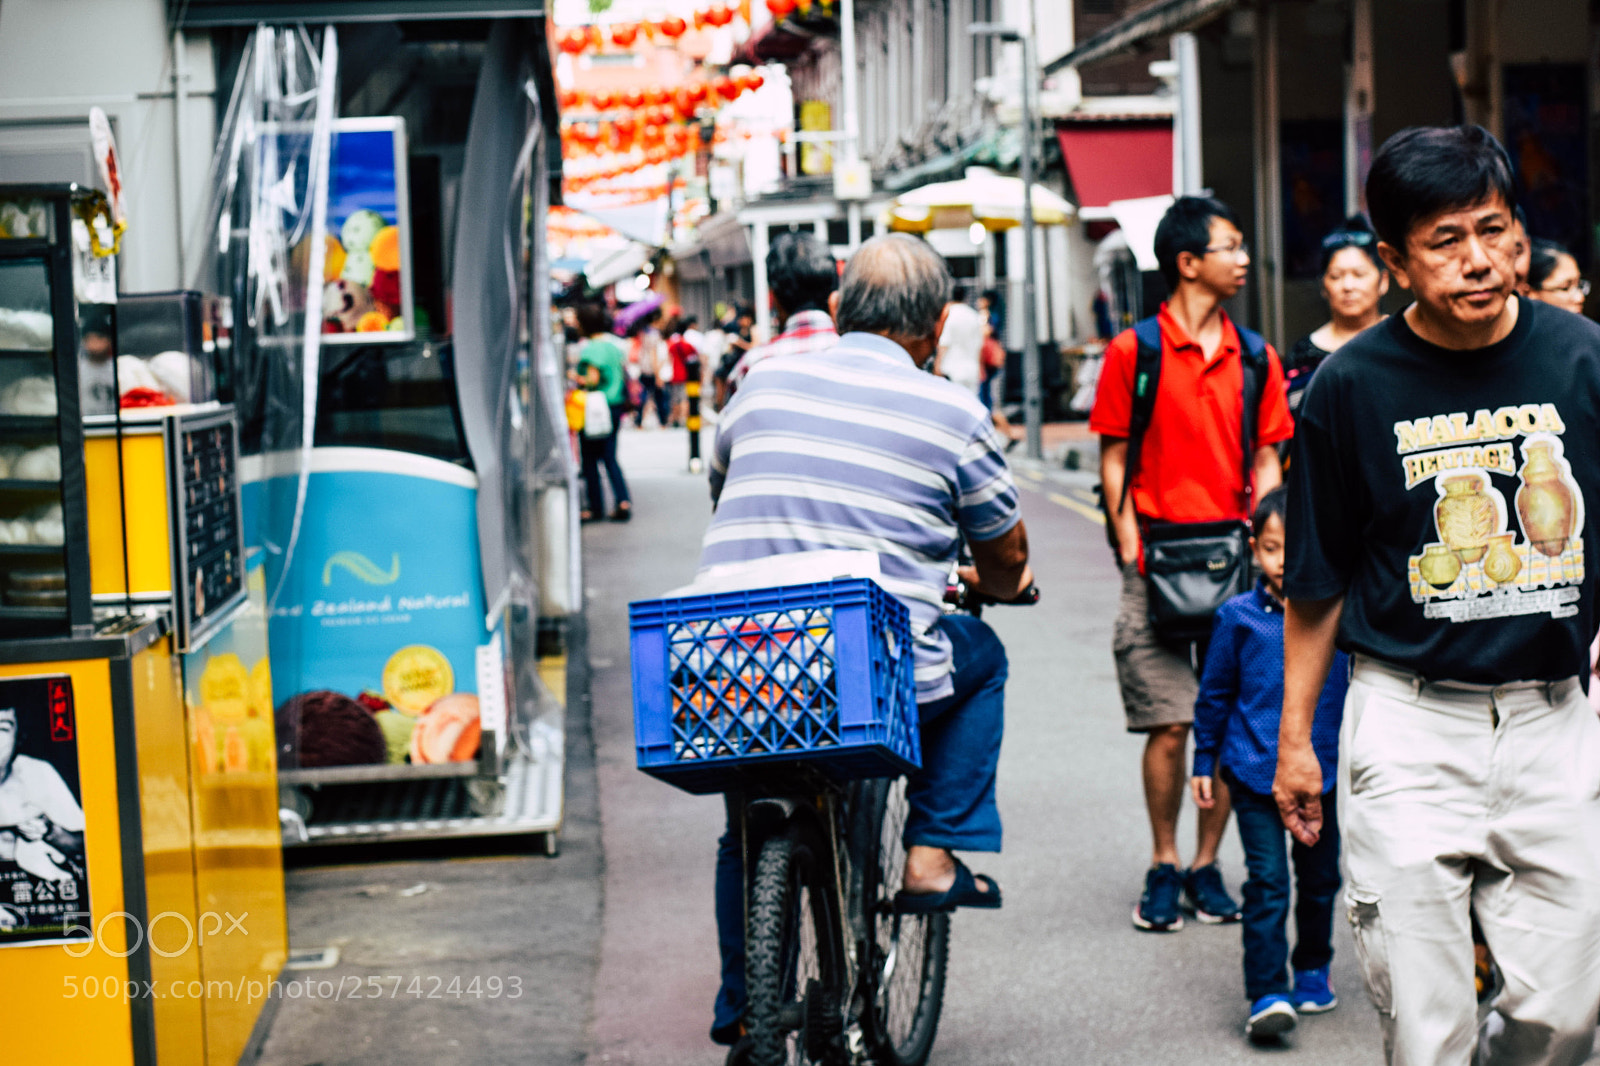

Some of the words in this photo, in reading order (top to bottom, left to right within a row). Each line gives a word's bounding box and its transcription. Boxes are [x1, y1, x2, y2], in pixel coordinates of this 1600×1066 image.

[1394, 403, 1566, 454] MALACCA
[1404, 443, 1515, 489] HERITAGE
[311, 597, 391, 616] Zealand
[399, 592, 469, 611] Natural
[11, 880, 79, 904] 雷公包
